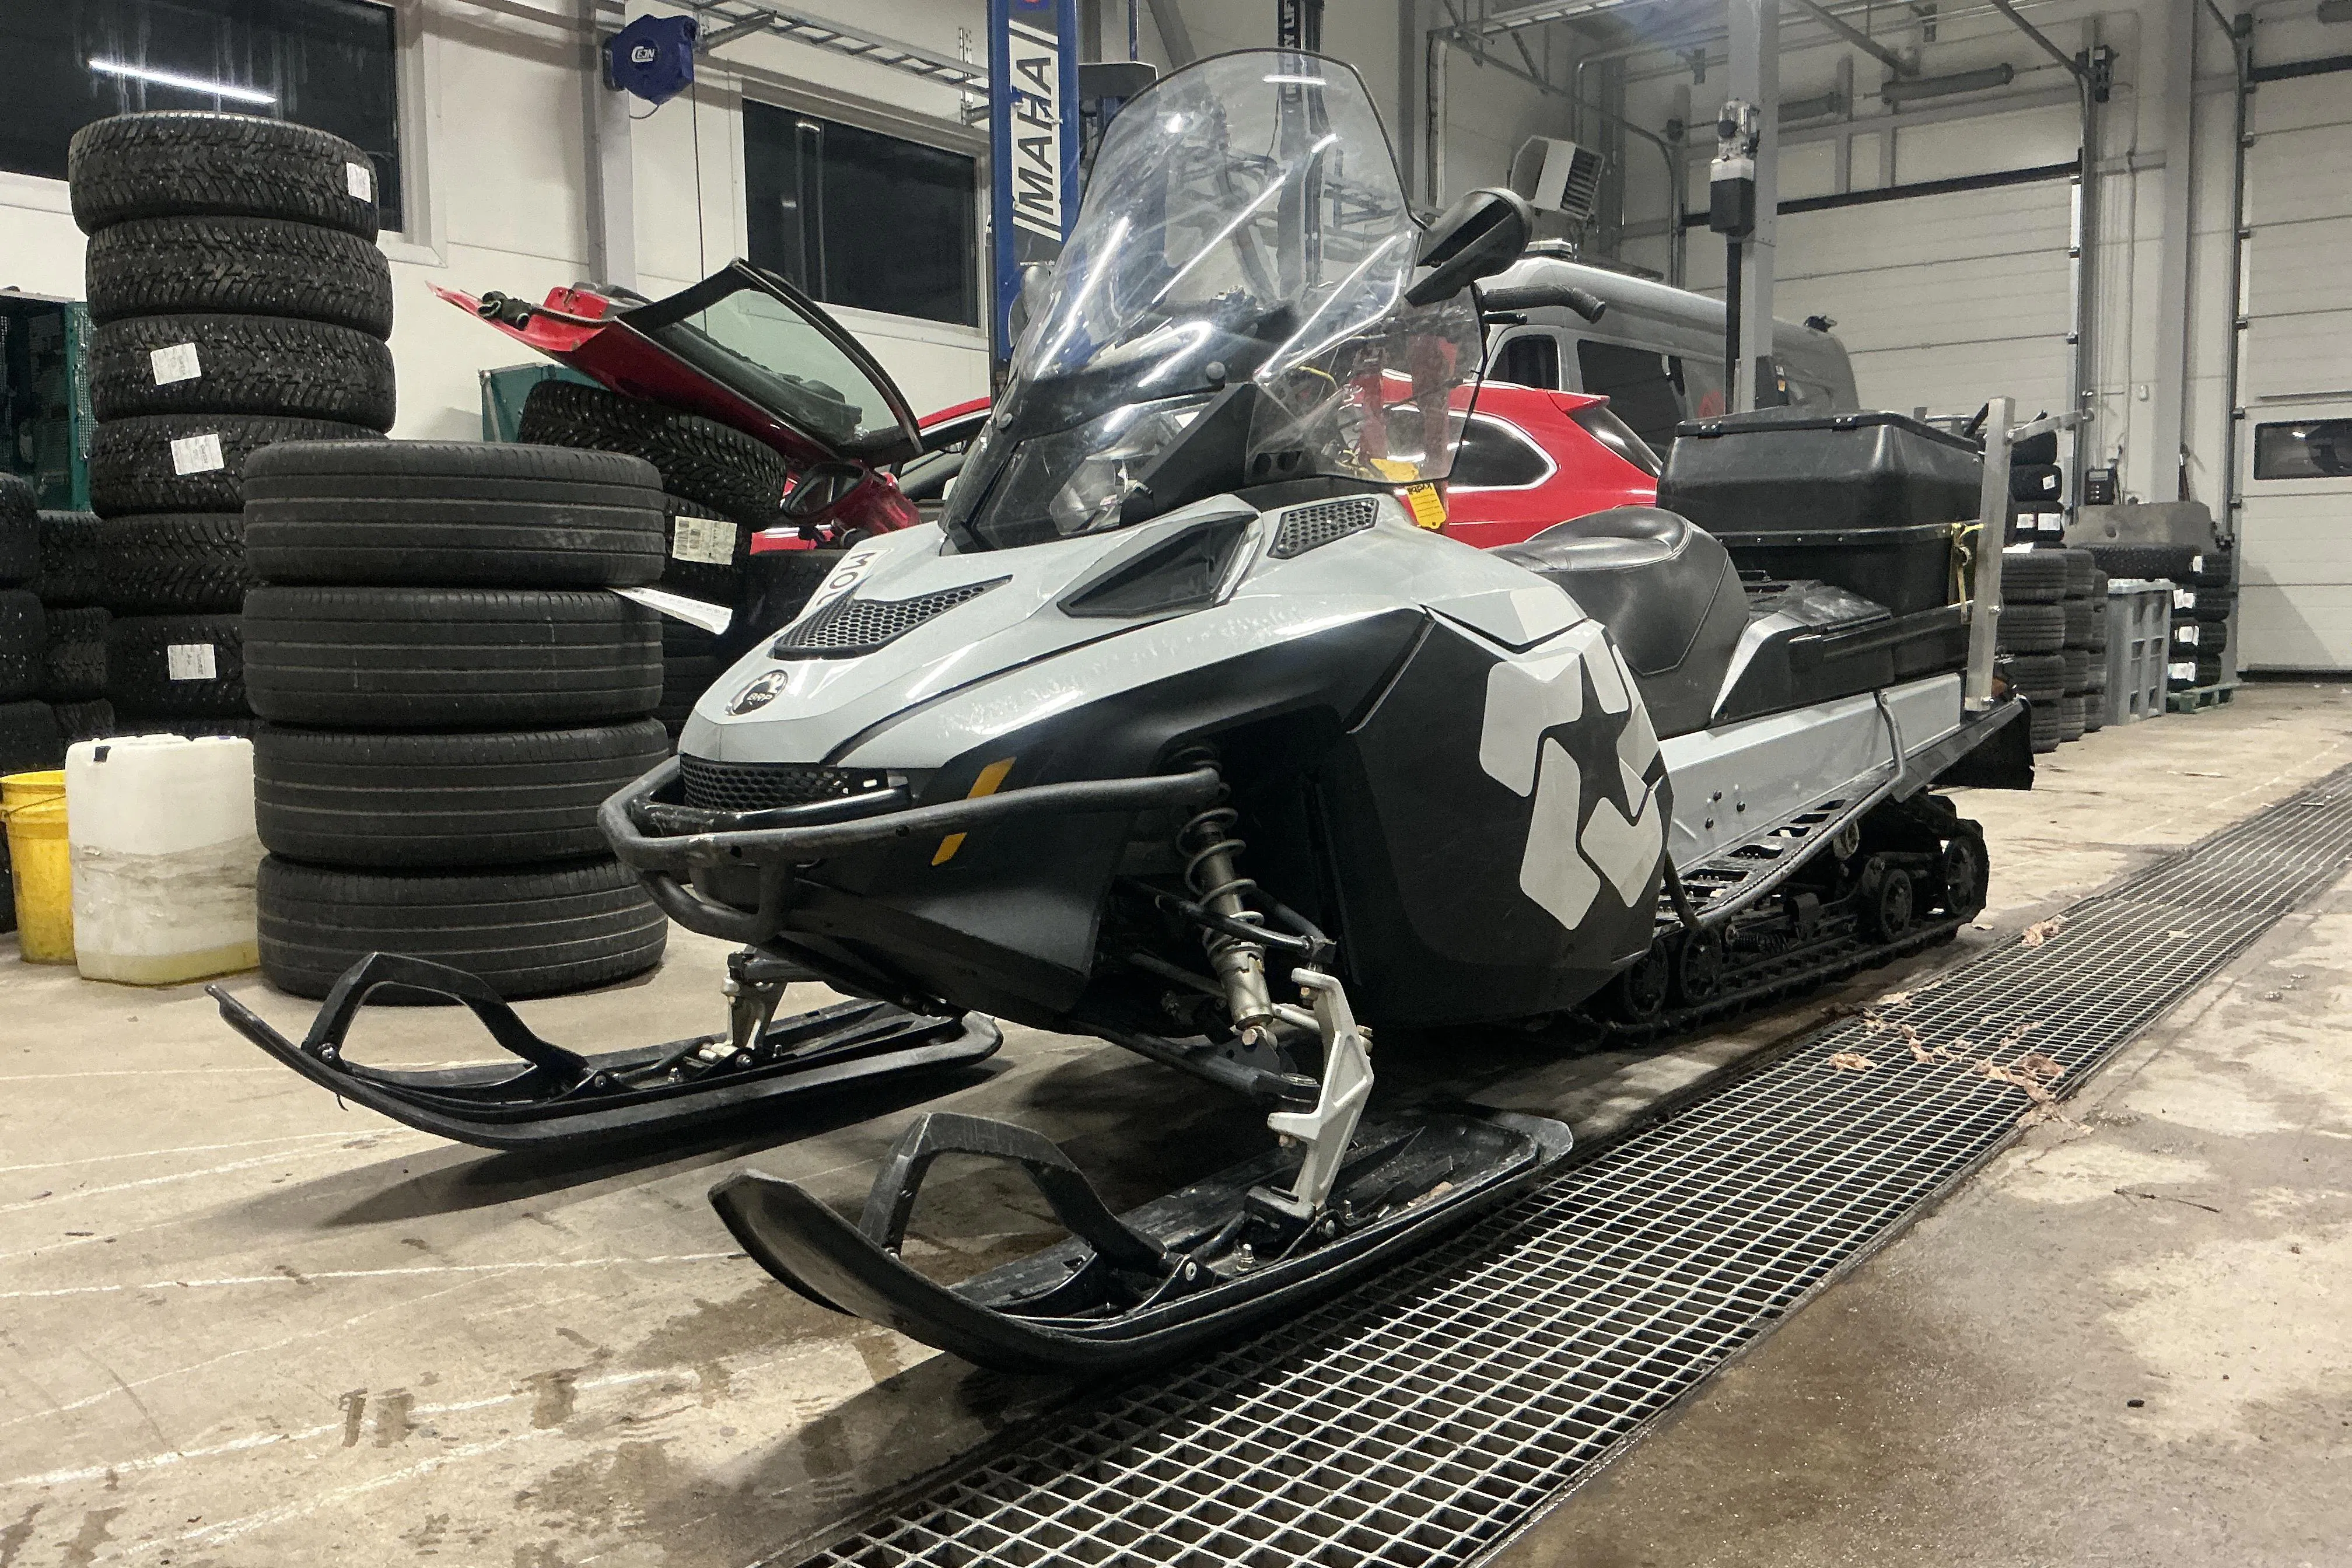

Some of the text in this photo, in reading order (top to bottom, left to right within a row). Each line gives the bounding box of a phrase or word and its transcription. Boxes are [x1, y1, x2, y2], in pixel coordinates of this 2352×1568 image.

[632, 46, 654, 62] CEJN
[1016, 57, 1054, 215] MAHA
[747, 692, 774, 702] BRP
